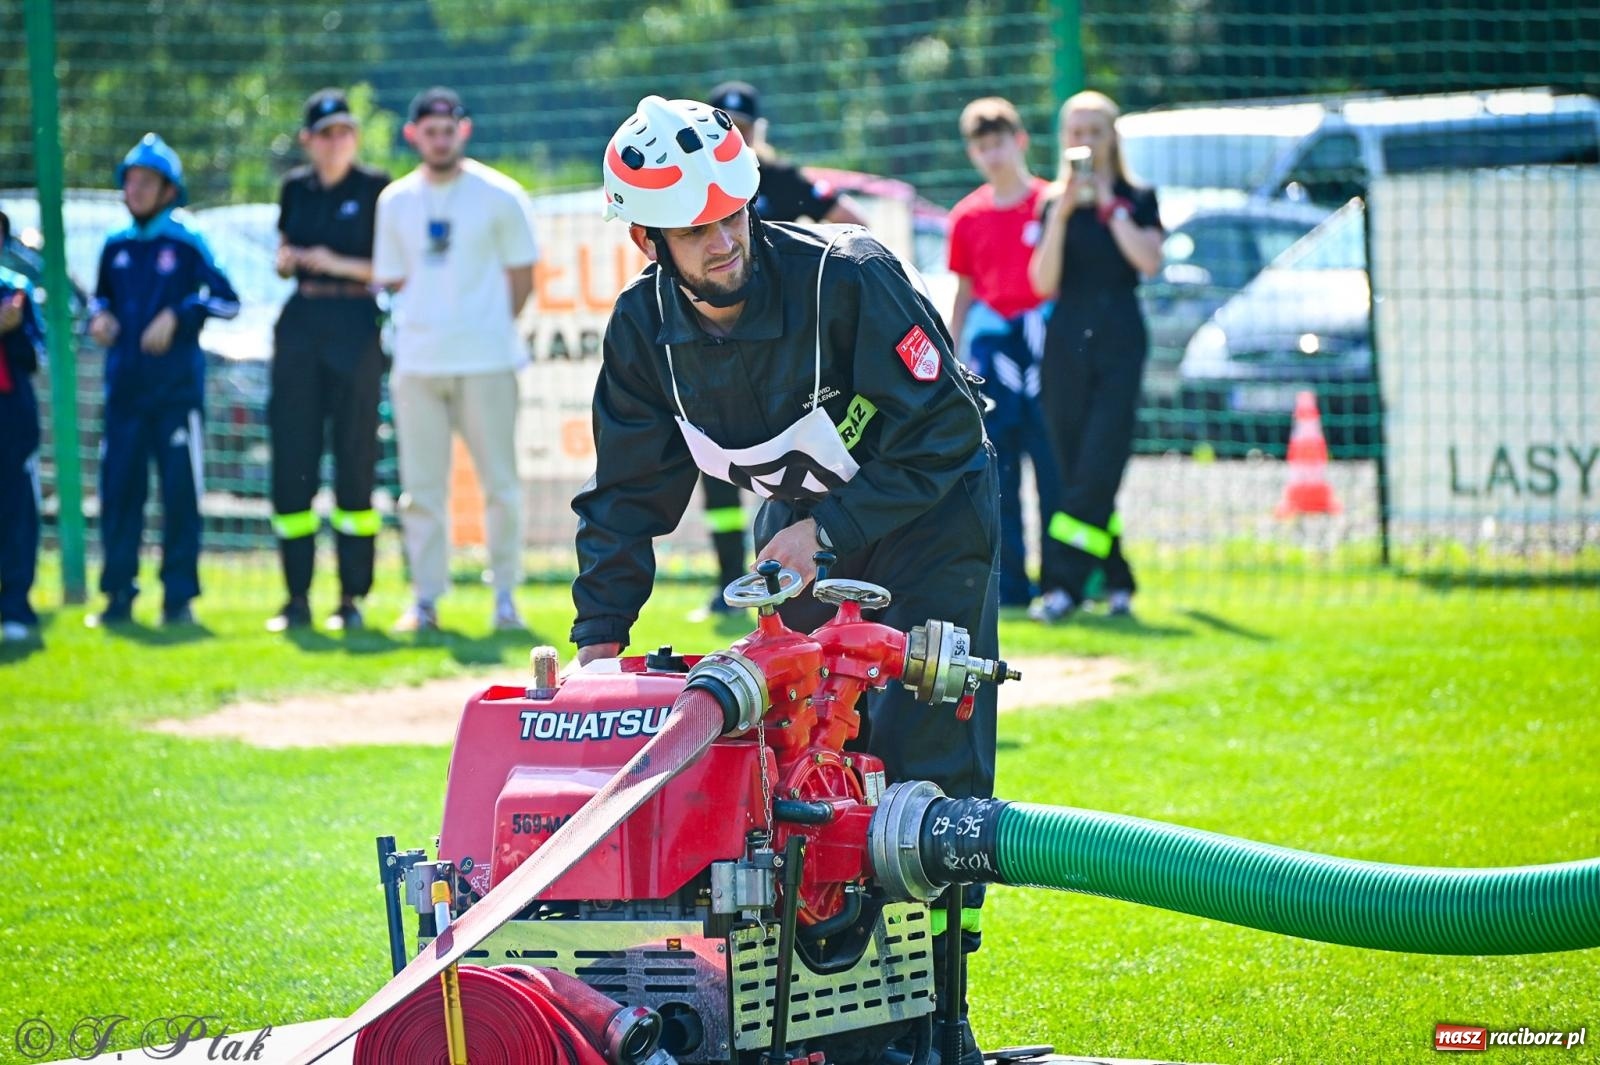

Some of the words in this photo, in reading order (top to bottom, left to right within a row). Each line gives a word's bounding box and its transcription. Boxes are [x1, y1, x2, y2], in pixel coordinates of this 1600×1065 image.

[802, 390, 840, 409] WYLENDA
[808, 386, 831, 400] DWID
[1450, 442, 1600, 496] LASY
[520, 706, 673, 740] TOHATSU
[931, 815, 984, 838] 569-62
